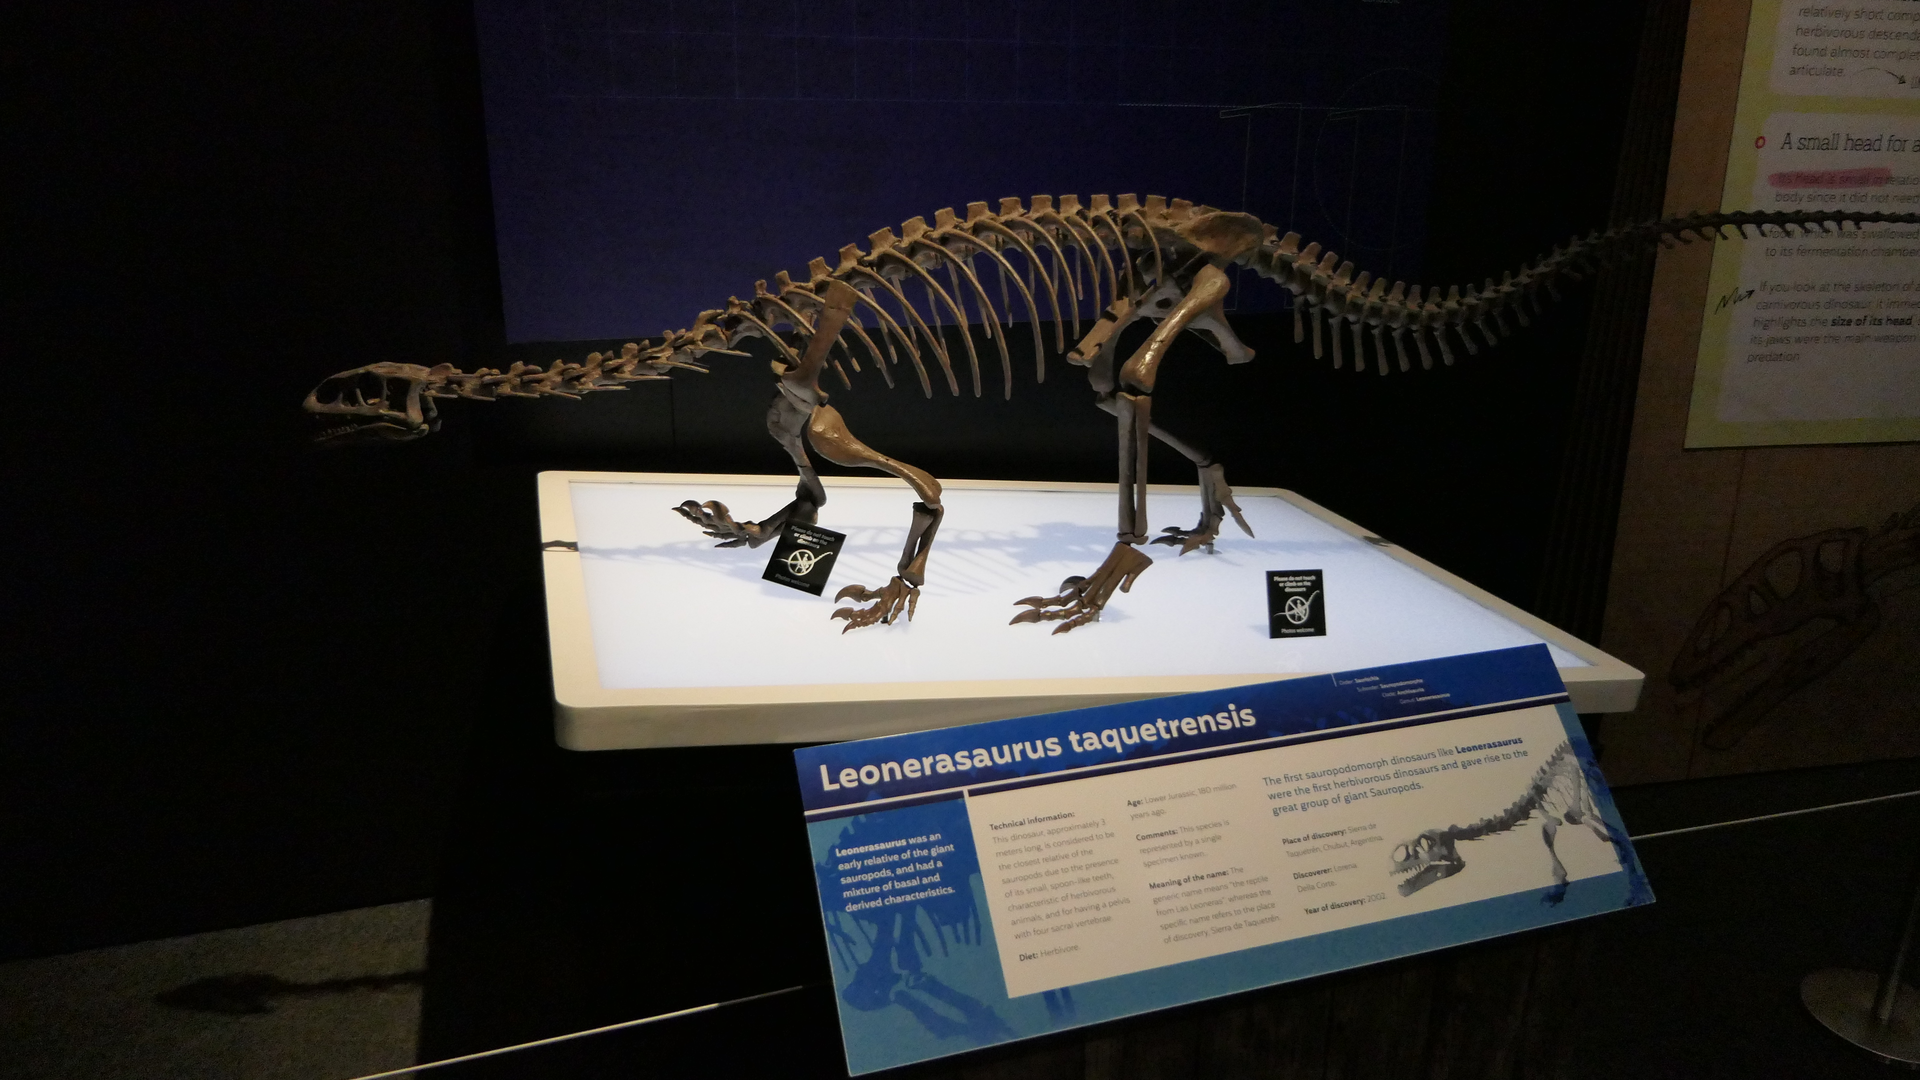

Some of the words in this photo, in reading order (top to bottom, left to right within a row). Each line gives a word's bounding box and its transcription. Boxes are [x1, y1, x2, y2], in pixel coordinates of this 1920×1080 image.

[1799, 6, 1850, 21] relatively
[1795, 25, 1865, 39] herbivorous
[1792, 44, 1828, 57] found
[1830, 46, 1870, 58] almost
[1781, 132, 1792, 150] A
[1797, 133, 1838, 151] small
[1843, 134, 1881, 152] head
[1886, 135, 1909, 152] for
[1775, 192, 1804, 204] body
[1807, 193, 1836, 203] since
[1849, 193, 1867, 203] did
[1871, 194, 1888, 203] not
[1853, 282, 1899, 292] skeleton
[1756, 299, 1820, 310] carnivorous
[1753, 316, 1806, 329] highlights
[1809, 316, 1828, 327] the
[1830, 316, 1852, 327] size
[1855, 316, 1867, 327] of
[1869, 316, 1883, 327] its
[1765, 335, 1791, 346] jaws
[1823, 335, 1841, 344] the
[820, 733, 1062, 791] Leonerasaurus
[1069, 703, 1257, 753] taquetrensis
[1263, 776, 1282, 786] The
[1284, 773, 1302, 783] first
[1305, 758, 1388, 780] sauropodomorph
[1390, 750, 1436, 767] dinosaurs
[1438, 747, 1453, 758] like
[1455, 737, 1523, 754] Leonerasaurus
[1268, 791, 1292, 801] were
[1294, 786, 1310, 797] the
[1312, 782, 1331, 793] first
[1334, 770, 1391, 789] herbivorous
[1393, 763, 1439, 780] dinosaurs
[1441, 760, 1458, 771] and
[1460, 757, 1482, 770] gave
[1484, 753, 1501, 764] rise
[1502, 752, 1512, 761] to
[1514, 748, 1528, 759] the
[1127, 799, 1143, 807] Age:
[1145, 795, 1166, 804] Lower
[1168, 789, 1196, 801] Jurassic,
[1198, 787, 1211, 795] 180
[1213, 783, 1237, 792] million
[1272, 804, 1299, 816] great
[1300, 798, 1328, 813] group
[1331, 795, 1341, 806] of
[1343, 791, 1368, 805] giant
[1369, 782, 1424, 800] Sauropods.
[990, 818, 1025, 831] Technical
[1027, 812, 1075, 825] information:
[1130, 812, 1149, 820] years
[993, 835, 1008, 844] This
[1047, 821, 1100, 836] approximately
[1136, 828, 1178, 841] Comments:
[1179, 826, 1194, 834] This
[1196, 821, 1222, 832] species
[1282, 837, 1301, 845] Place
[1311, 828, 1347, 840] discovery:
[1348, 825, 1367, 834] Sierra
[1368, 822, 1376, 830] de
[836, 838, 907, 857] Leonerasaurus
[908, 836, 928, 845] was
[929, 833, 941, 841] an
[996, 847, 1023, 857] meters
[1045, 840, 1051, 849] is
[1053, 833, 1094, 848] considered
[1096, 832, 1103, 841] to
[1105, 830, 1115, 838] be
[1139, 840, 1182, 854] represented
[1184, 839, 1194, 848] by
[1201, 834, 1222, 844] single
[838, 860, 862, 871] early
[864, 854, 899, 866] relative
[901, 850, 911, 859] of
[913, 847, 929, 858] the
[931, 844, 955, 857] giant
[999, 861, 1011, 871] the
[1013, 857, 1040, 869] closest
[1042, 852, 1070, 863] relative
[1071, 849, 1079, 858] of
[1081, 847, 1093, 857] the
[1143, 855, 1178, 868] specimen
[840, 869, 895, 884] sauropods,
[896, 863, 914, 875] and
[916, 860, 935, 871] had
[936, 860, 943, 868] a
[1002, 870, 1043, 885] sauropods
[1044, 867, 1059, 877] due
[1061, 865, 1069, 874] to
[1071, 863, 1083, 872] the
[1085, 857, 1119, 871] presence
[1149, 879, 1182, 890] Meaning
[1183, 875, 1191, 884] of
[1193, 873, 1204, 882] the
[1206, 870, 1229, 879] name:
[1230, 866, 1243, 874] The
[1293, 866, 1333, 880] Discoverer:
[843, 885, 881, 898] mixture
[882, 881, 893, 891] of
[894, 876, 920, 889] basal
[922, 872, 941, 884] and
[1004, 889, 1013, 899] of
[1014, 887, 1024, 897] its
[1153, 892, 1179, 904] generic
[1181, 888, 1202, 898] name
[1204, 884, 1229, 893] means
[1246, 875, 1269, 887] reptile
[1297, 882, 1315, 893] Della
[845, 897, 882, 912] derived
[885, 886, 956, 905] characteristics.
[1008, 896, 1059, 912] characteristic
[1061, 893, 1069, 902] of
[1070, 885, 1116, 899] herbivorous
[1045, 910, 1060, 920] and
[1062, 907, 1073, 916] for
[1074, 902, 1100, 914] having
[1102, 901, 1107, 909] a
[1108, 896, 1130, 908] pelvis
[1156, 908, 1174, 917] from
[1176, 904, 1188, 913] Las
[1228, 891, 1258, 903] whereas
[1260, 888, 1271, 897] the
[1304, 906, 1319, 915] Year
[1321, 903, 1329, 912] of
[1330, 897, 1367, 910] discovery:
[1160, 919, 1187, 931] specific
[1189, 915, 1210, 924] name
[1212, 910, 1232, 920] refers
[1234, 908, 1242, 916] to
[1243, 905, 1255, 914] the
[1257, 901, 1275, 912] place
[1014, 929, 1032, 940] with
[1033, 926, 1049, 936] four
[1051, 921, 1074, 933] sacral
[1163, 935, 1171, 944] of
[1210, 925, 1232, 935] Sierra
[1233, 922, 1243, 931] de
[1019, 952, 1039, 962] Diet:
